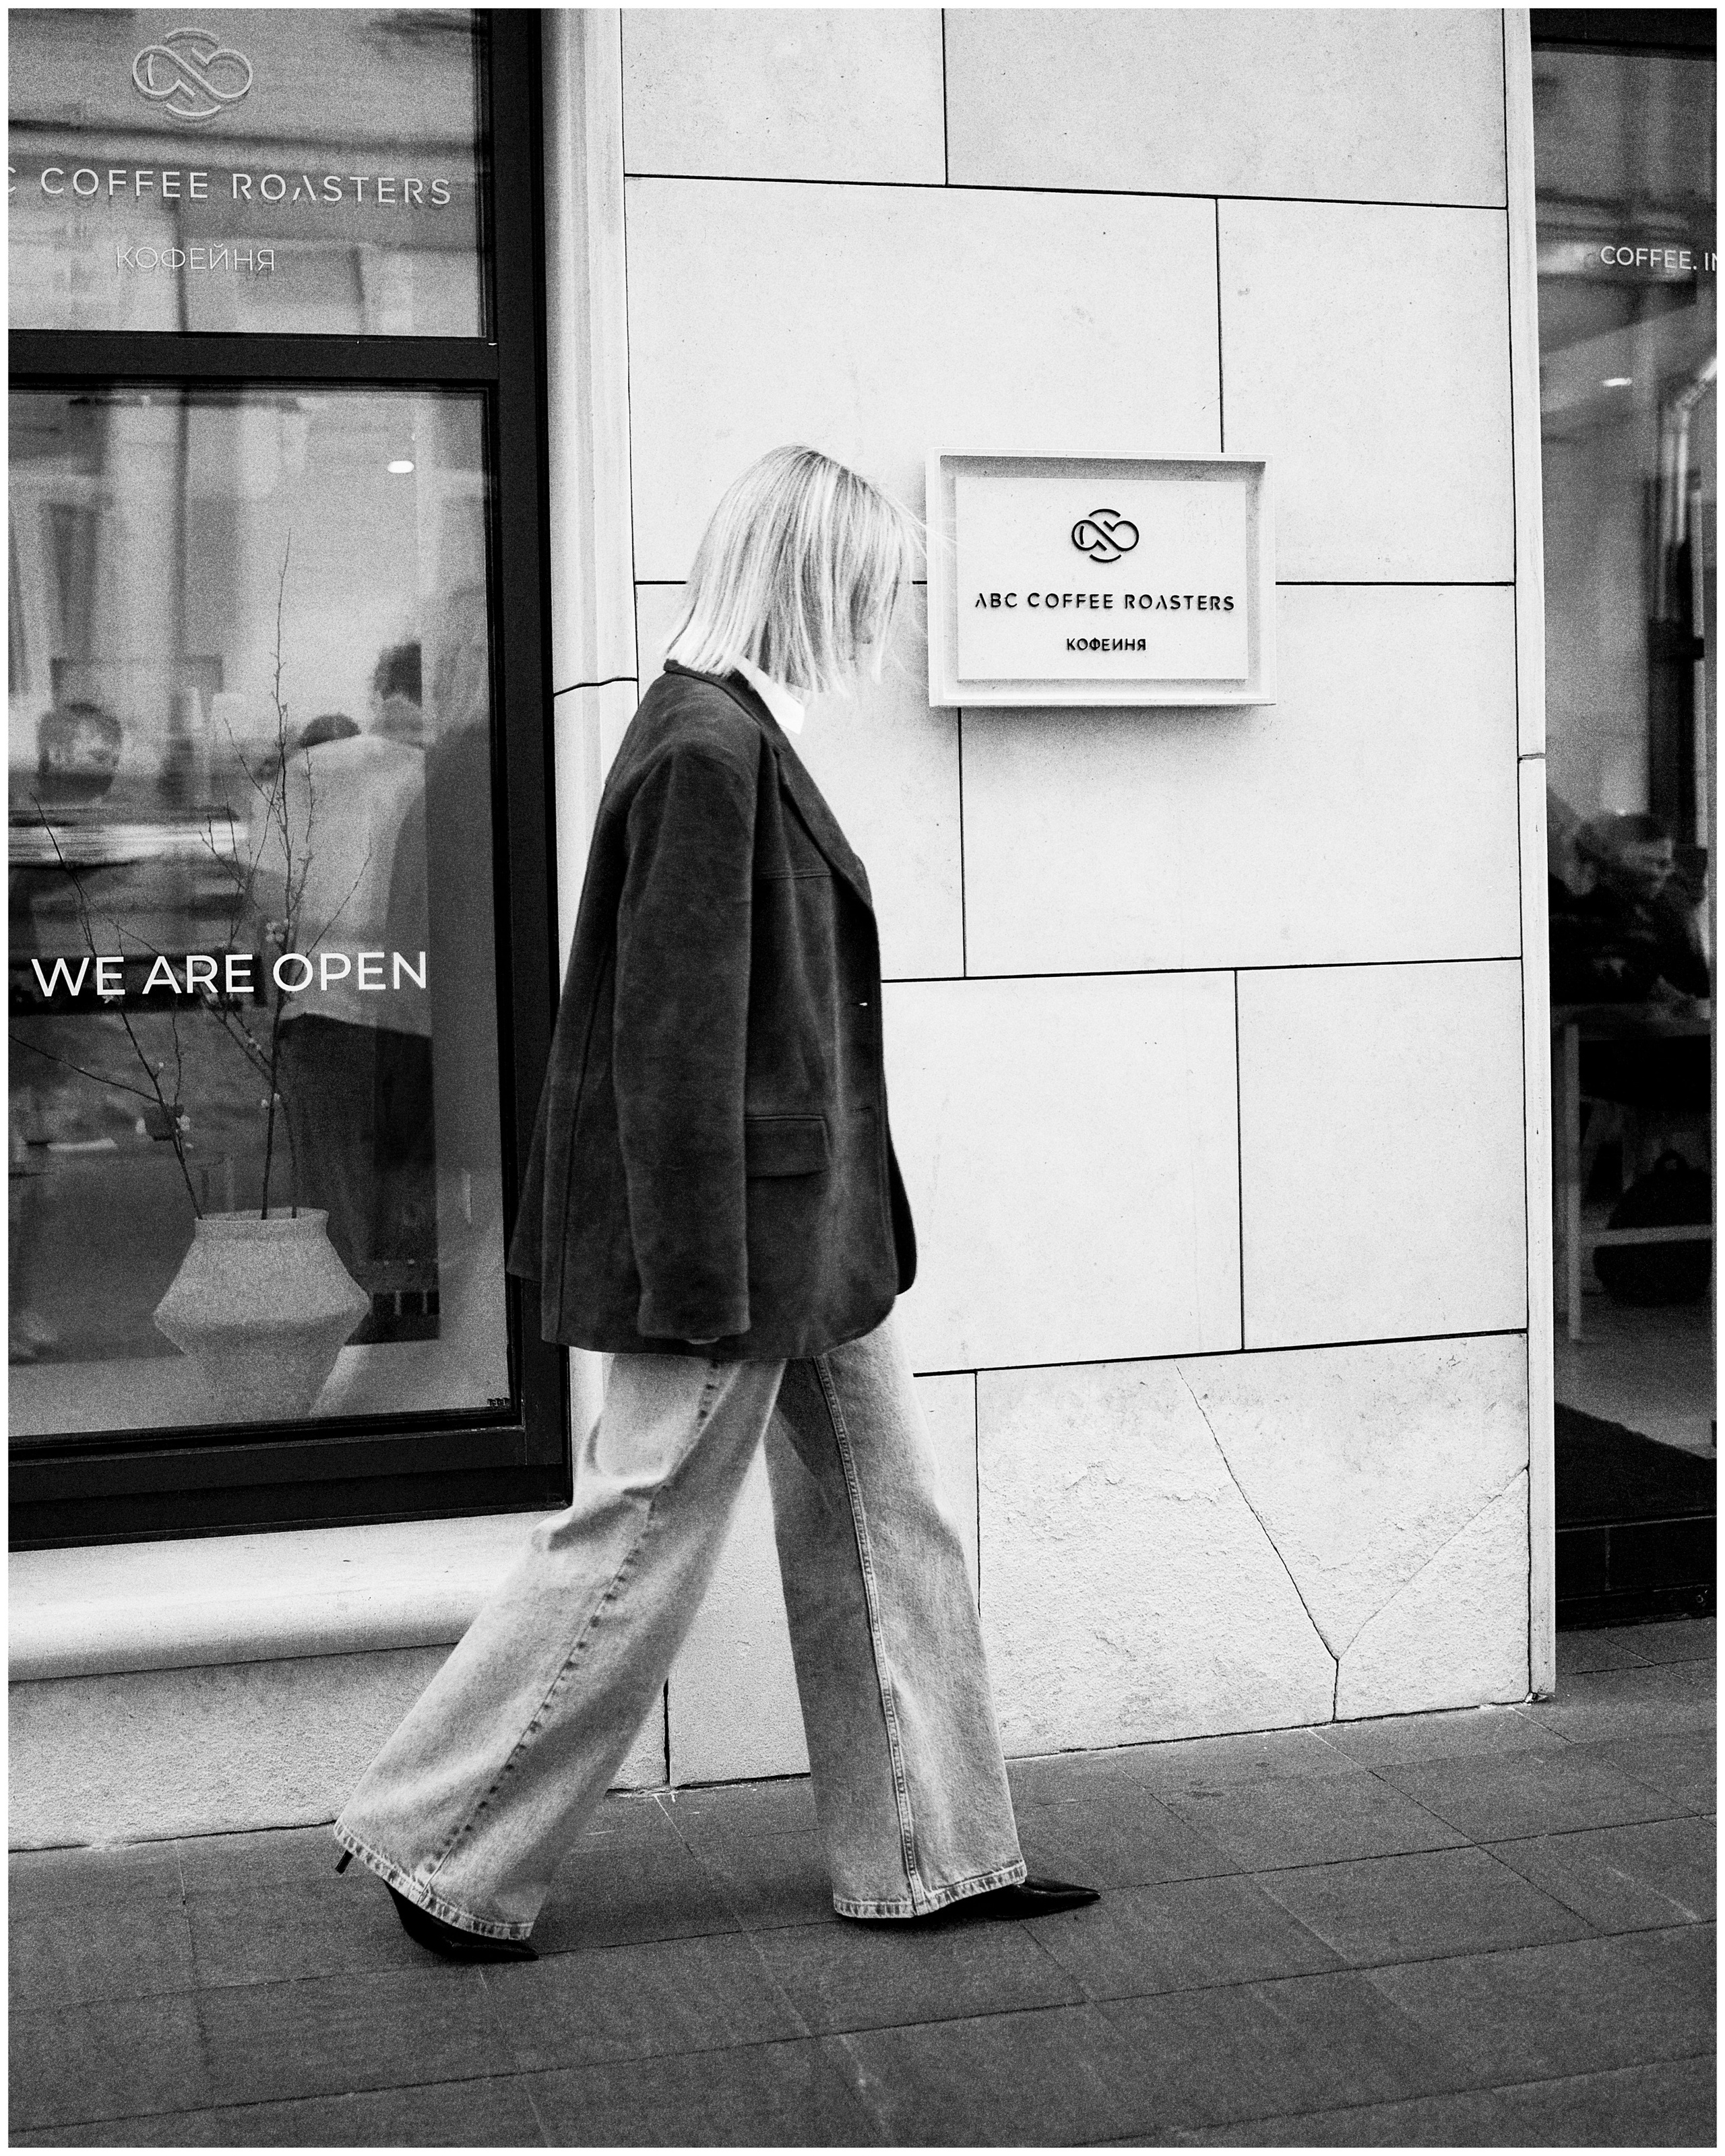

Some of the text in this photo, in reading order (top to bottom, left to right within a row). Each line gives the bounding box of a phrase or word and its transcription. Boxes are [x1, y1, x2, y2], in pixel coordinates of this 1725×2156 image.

[40, 167, 209, 199] COFFEE
[232, 173, 451, 205] ROASTERS
[116, 243, 275, 271] КОФЕЙНЯ
[1600, 245, 1697, 270] COFFEE.
[974, 592, 1236, 611] ABC COFFEE ROASTERS
[30, 951, 427, 997] WE ARE OPEN
